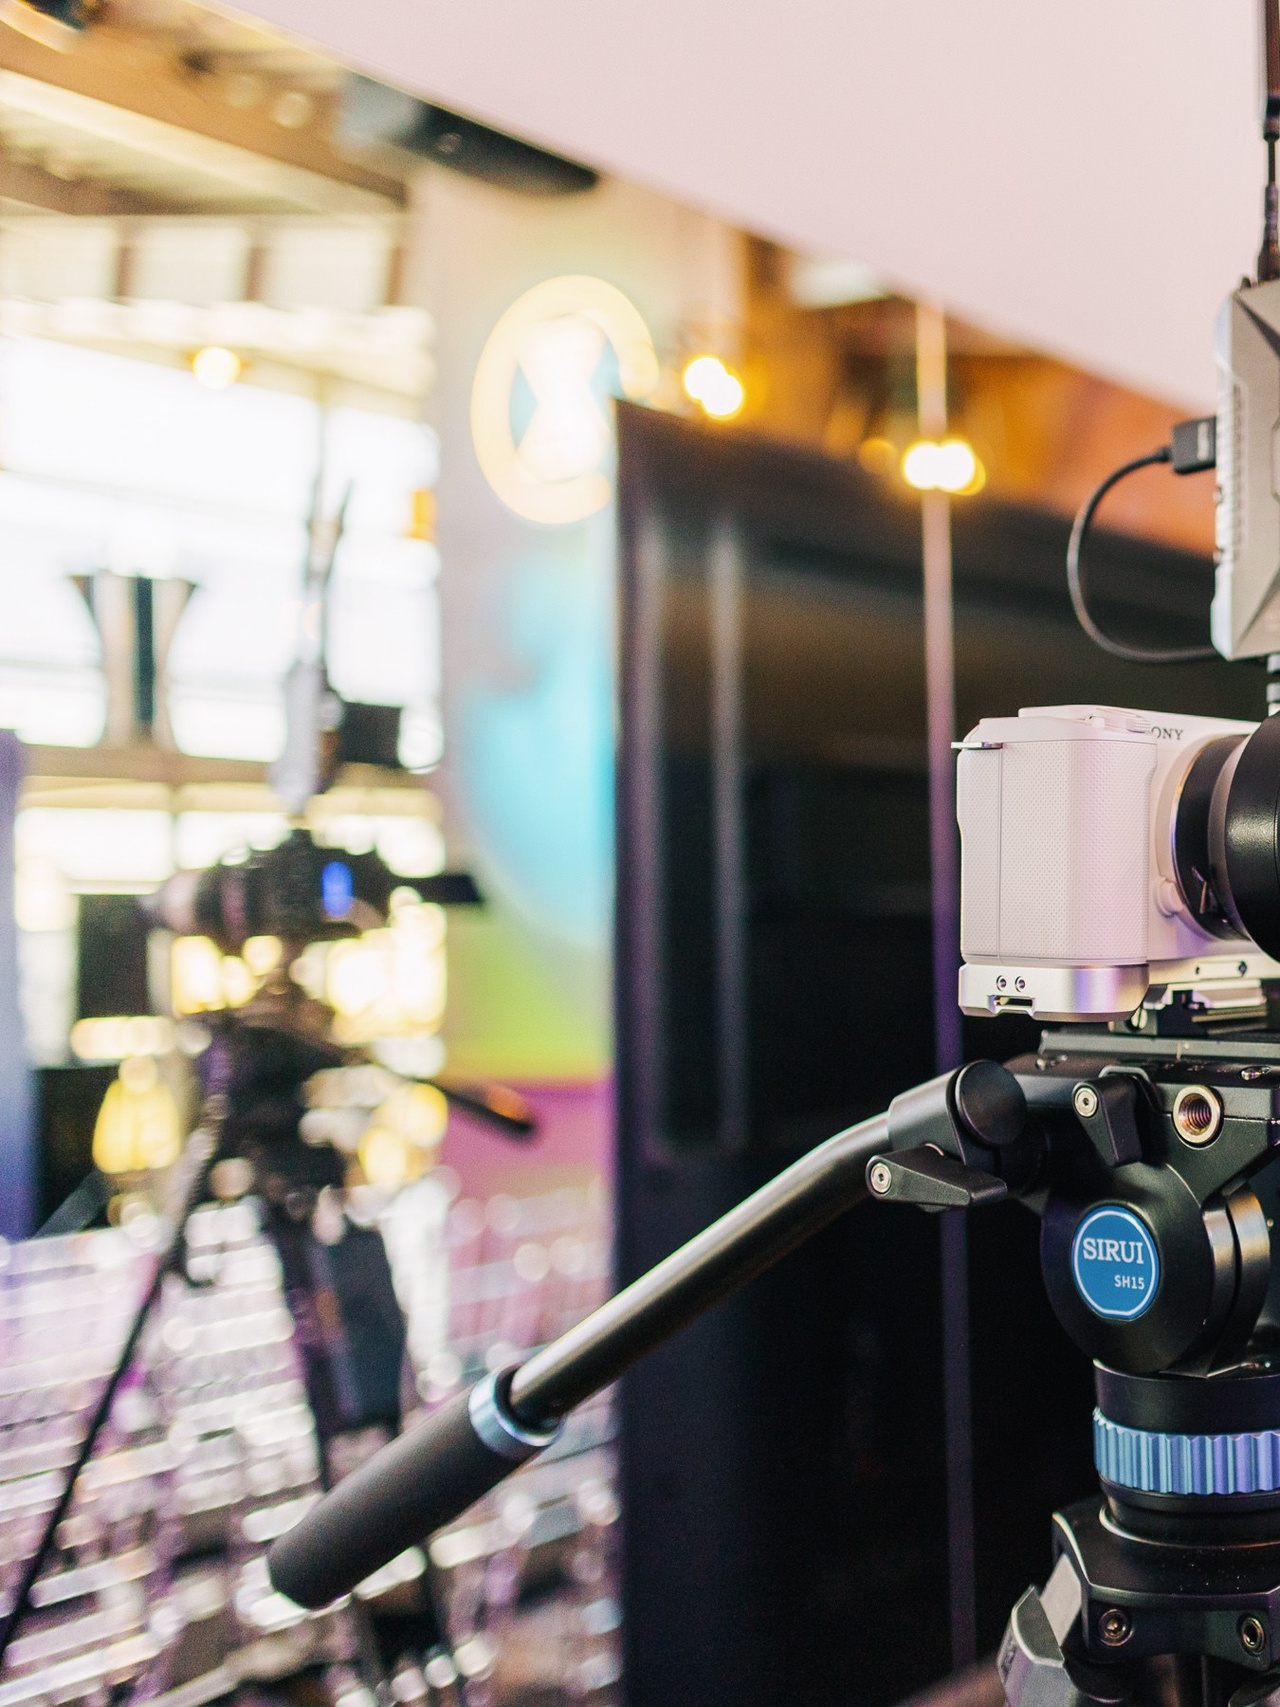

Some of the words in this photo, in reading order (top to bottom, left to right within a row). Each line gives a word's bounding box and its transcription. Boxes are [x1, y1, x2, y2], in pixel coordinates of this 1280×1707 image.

[1151, 726, 1184, 740] ONY
[1082, 1238, 1144, 1264] SIRUI
[1114, 1274, 1145, 1290] SH15
